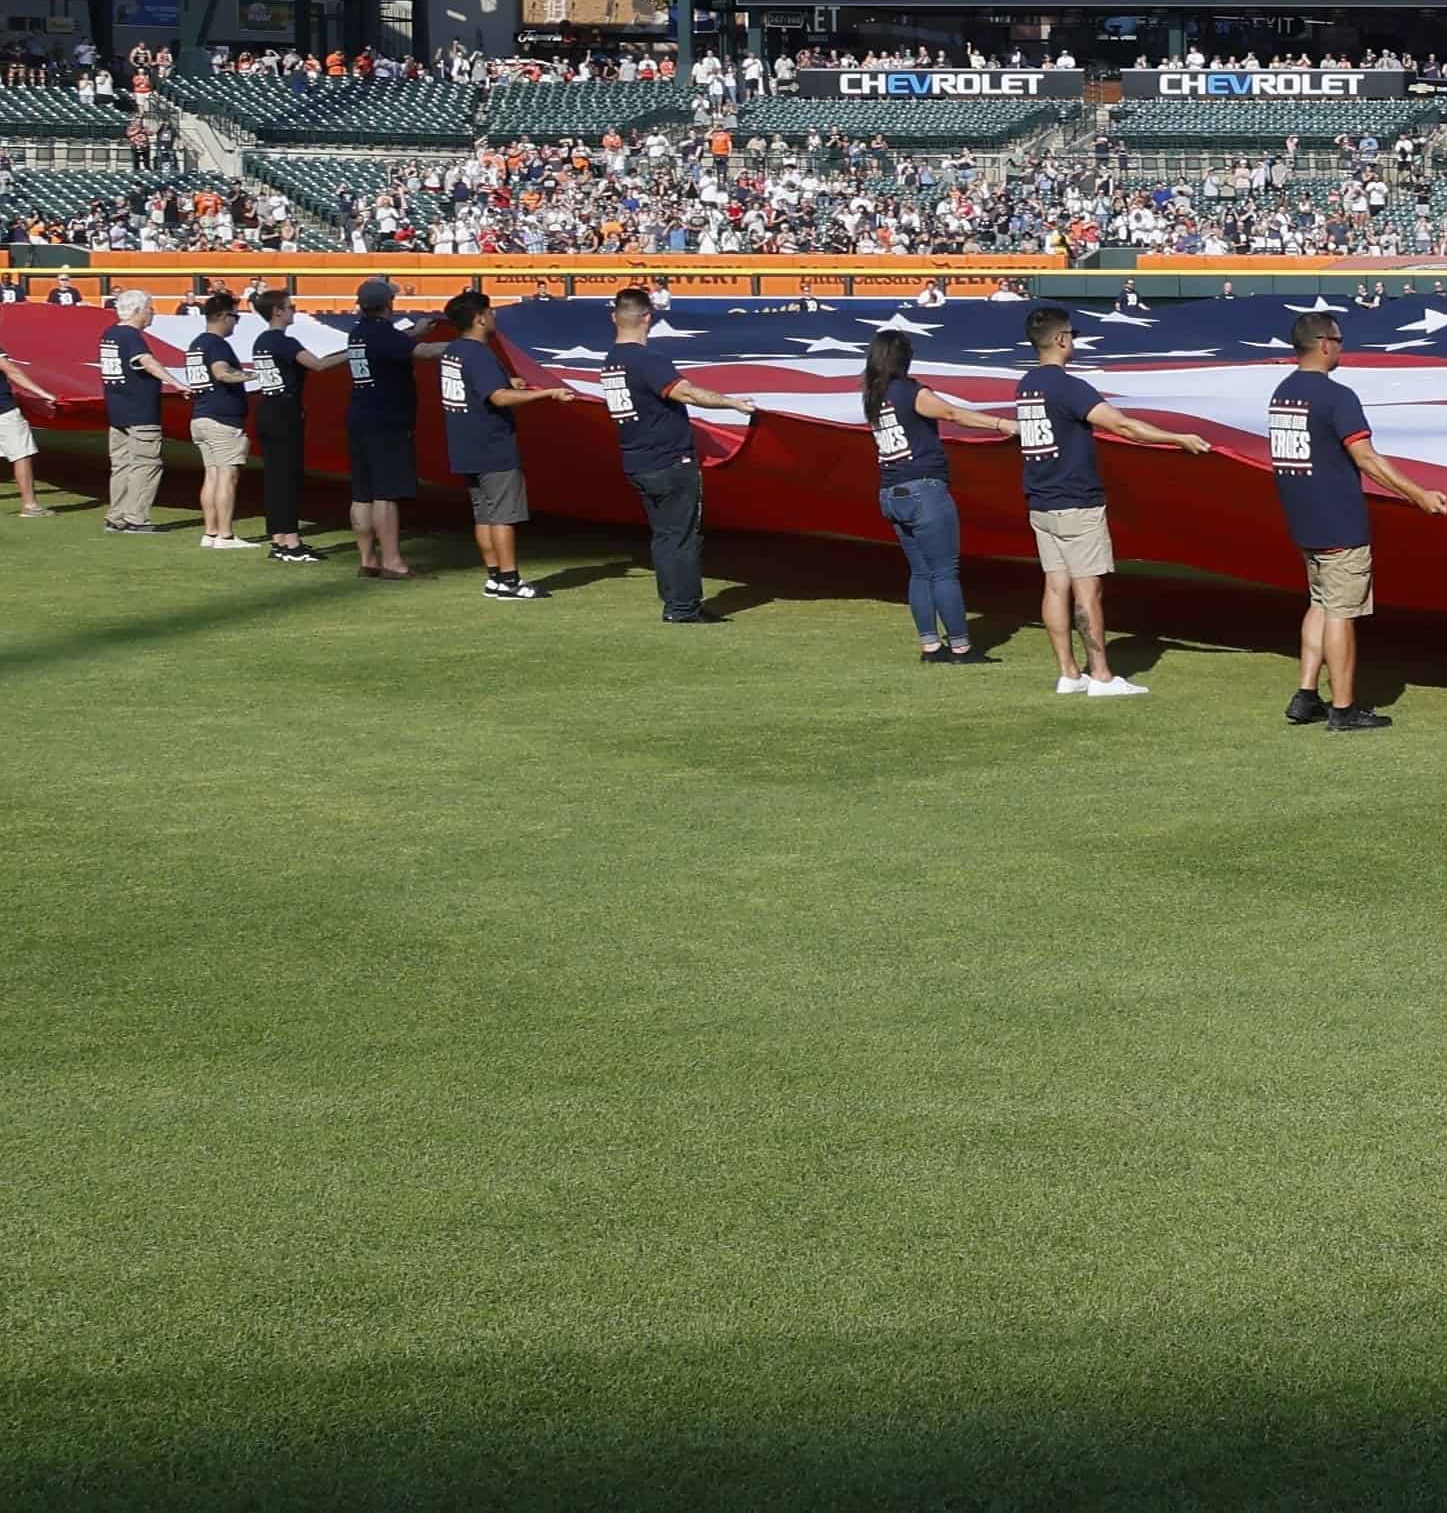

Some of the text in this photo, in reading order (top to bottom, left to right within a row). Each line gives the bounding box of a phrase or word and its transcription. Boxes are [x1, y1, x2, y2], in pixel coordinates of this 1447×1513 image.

[806, 6, 841, 32] ET
[840, 73, 1044, 95] CHEVROLET
[1159, 73, 1365, 95] CHEVROLET
[1270, 429, 1312, 461] EROES
